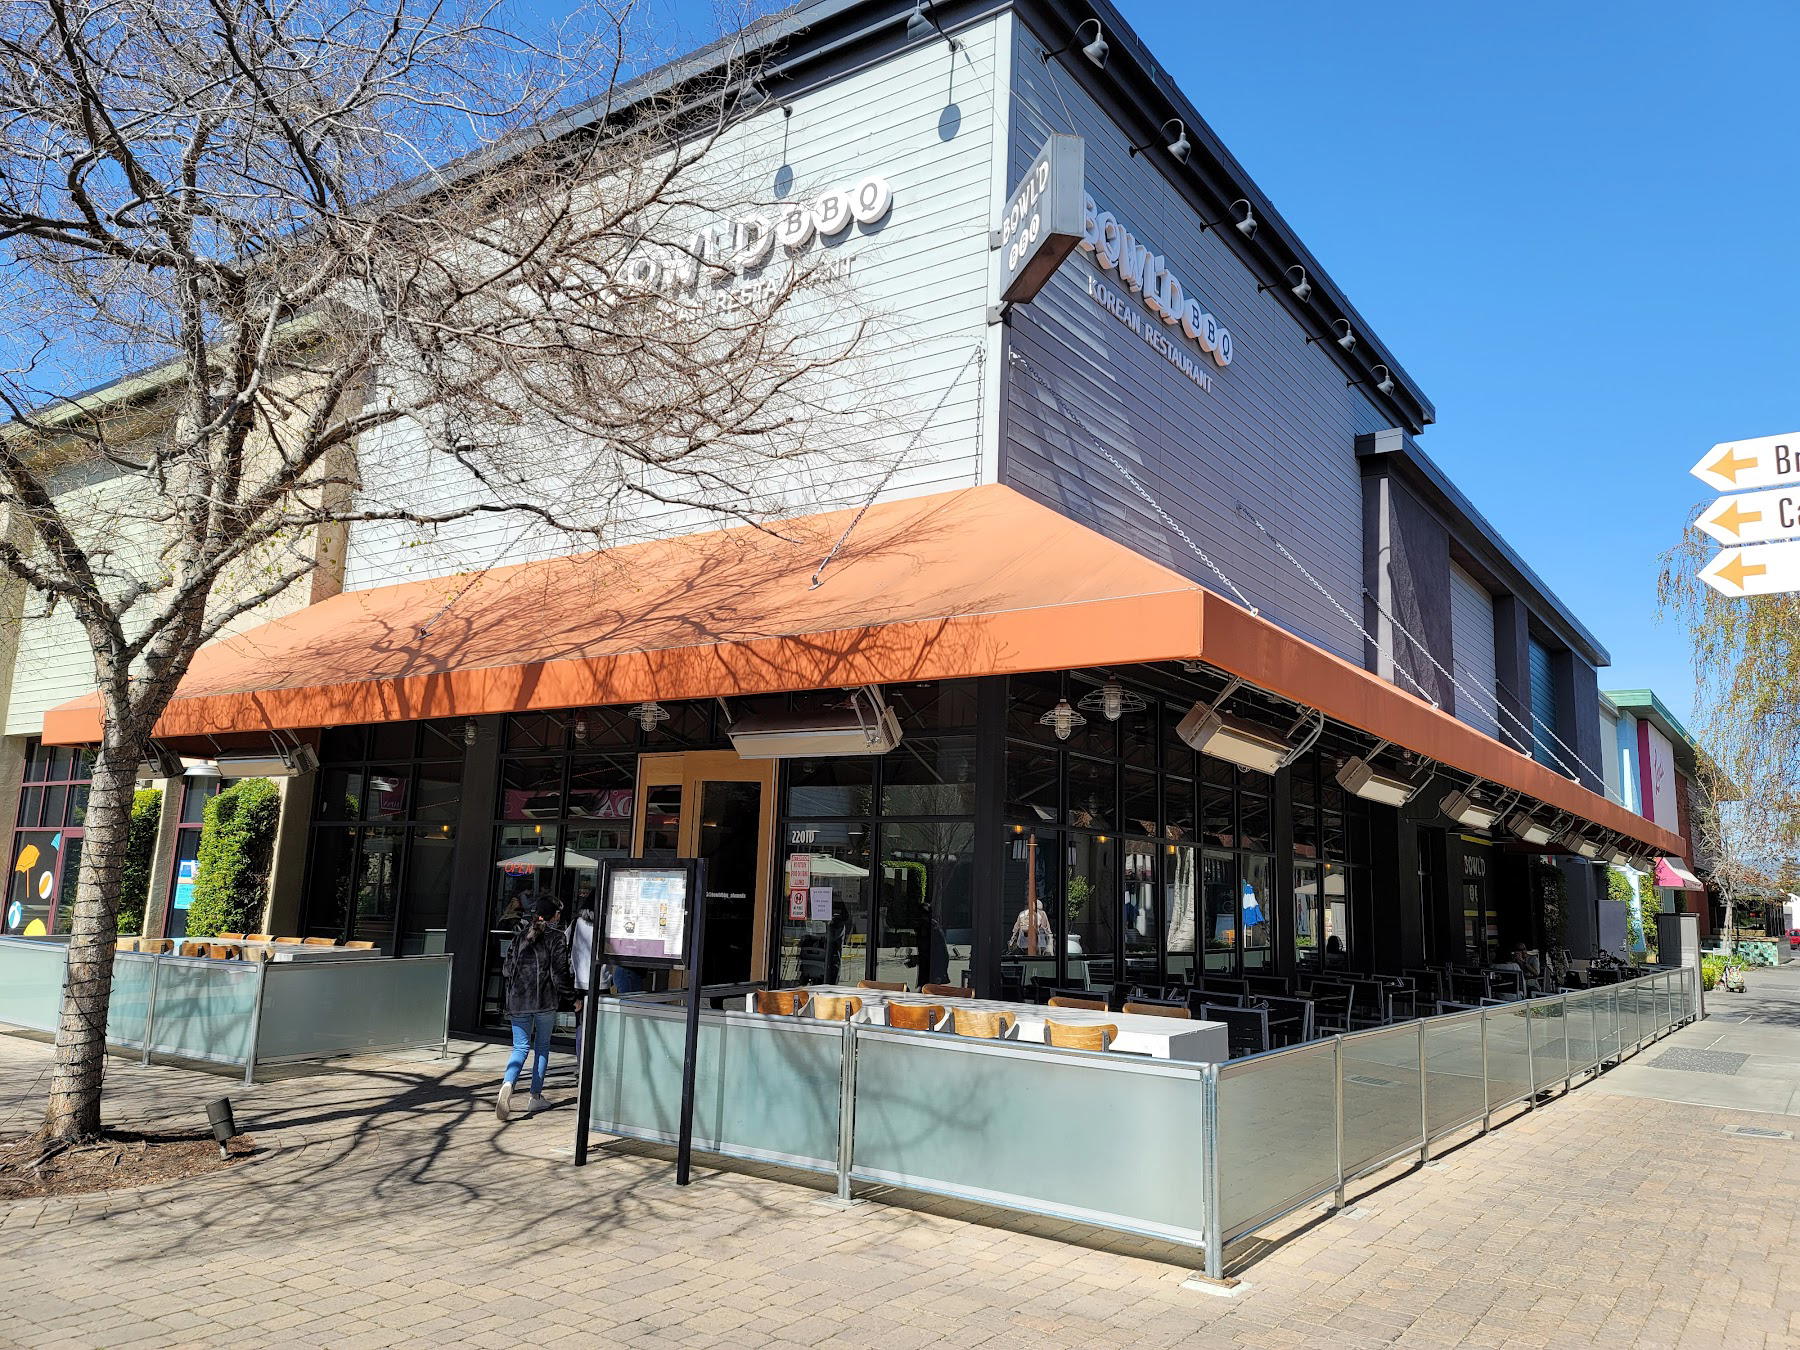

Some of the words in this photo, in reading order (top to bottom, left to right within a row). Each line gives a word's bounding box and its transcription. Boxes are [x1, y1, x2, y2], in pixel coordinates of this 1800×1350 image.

[780, 178, 886, 241] BBQ
[1003, 161, 1049, 246] BOWL'D
[1088, 275, 1141, 335] KOREAN
[1144, 322, 1213, 393] RESTAURANT
[1184, 300, 1233, 365] BBQ
[1779, 498, 1800, 528] C
[504, 862, 535, 874] OPEN
